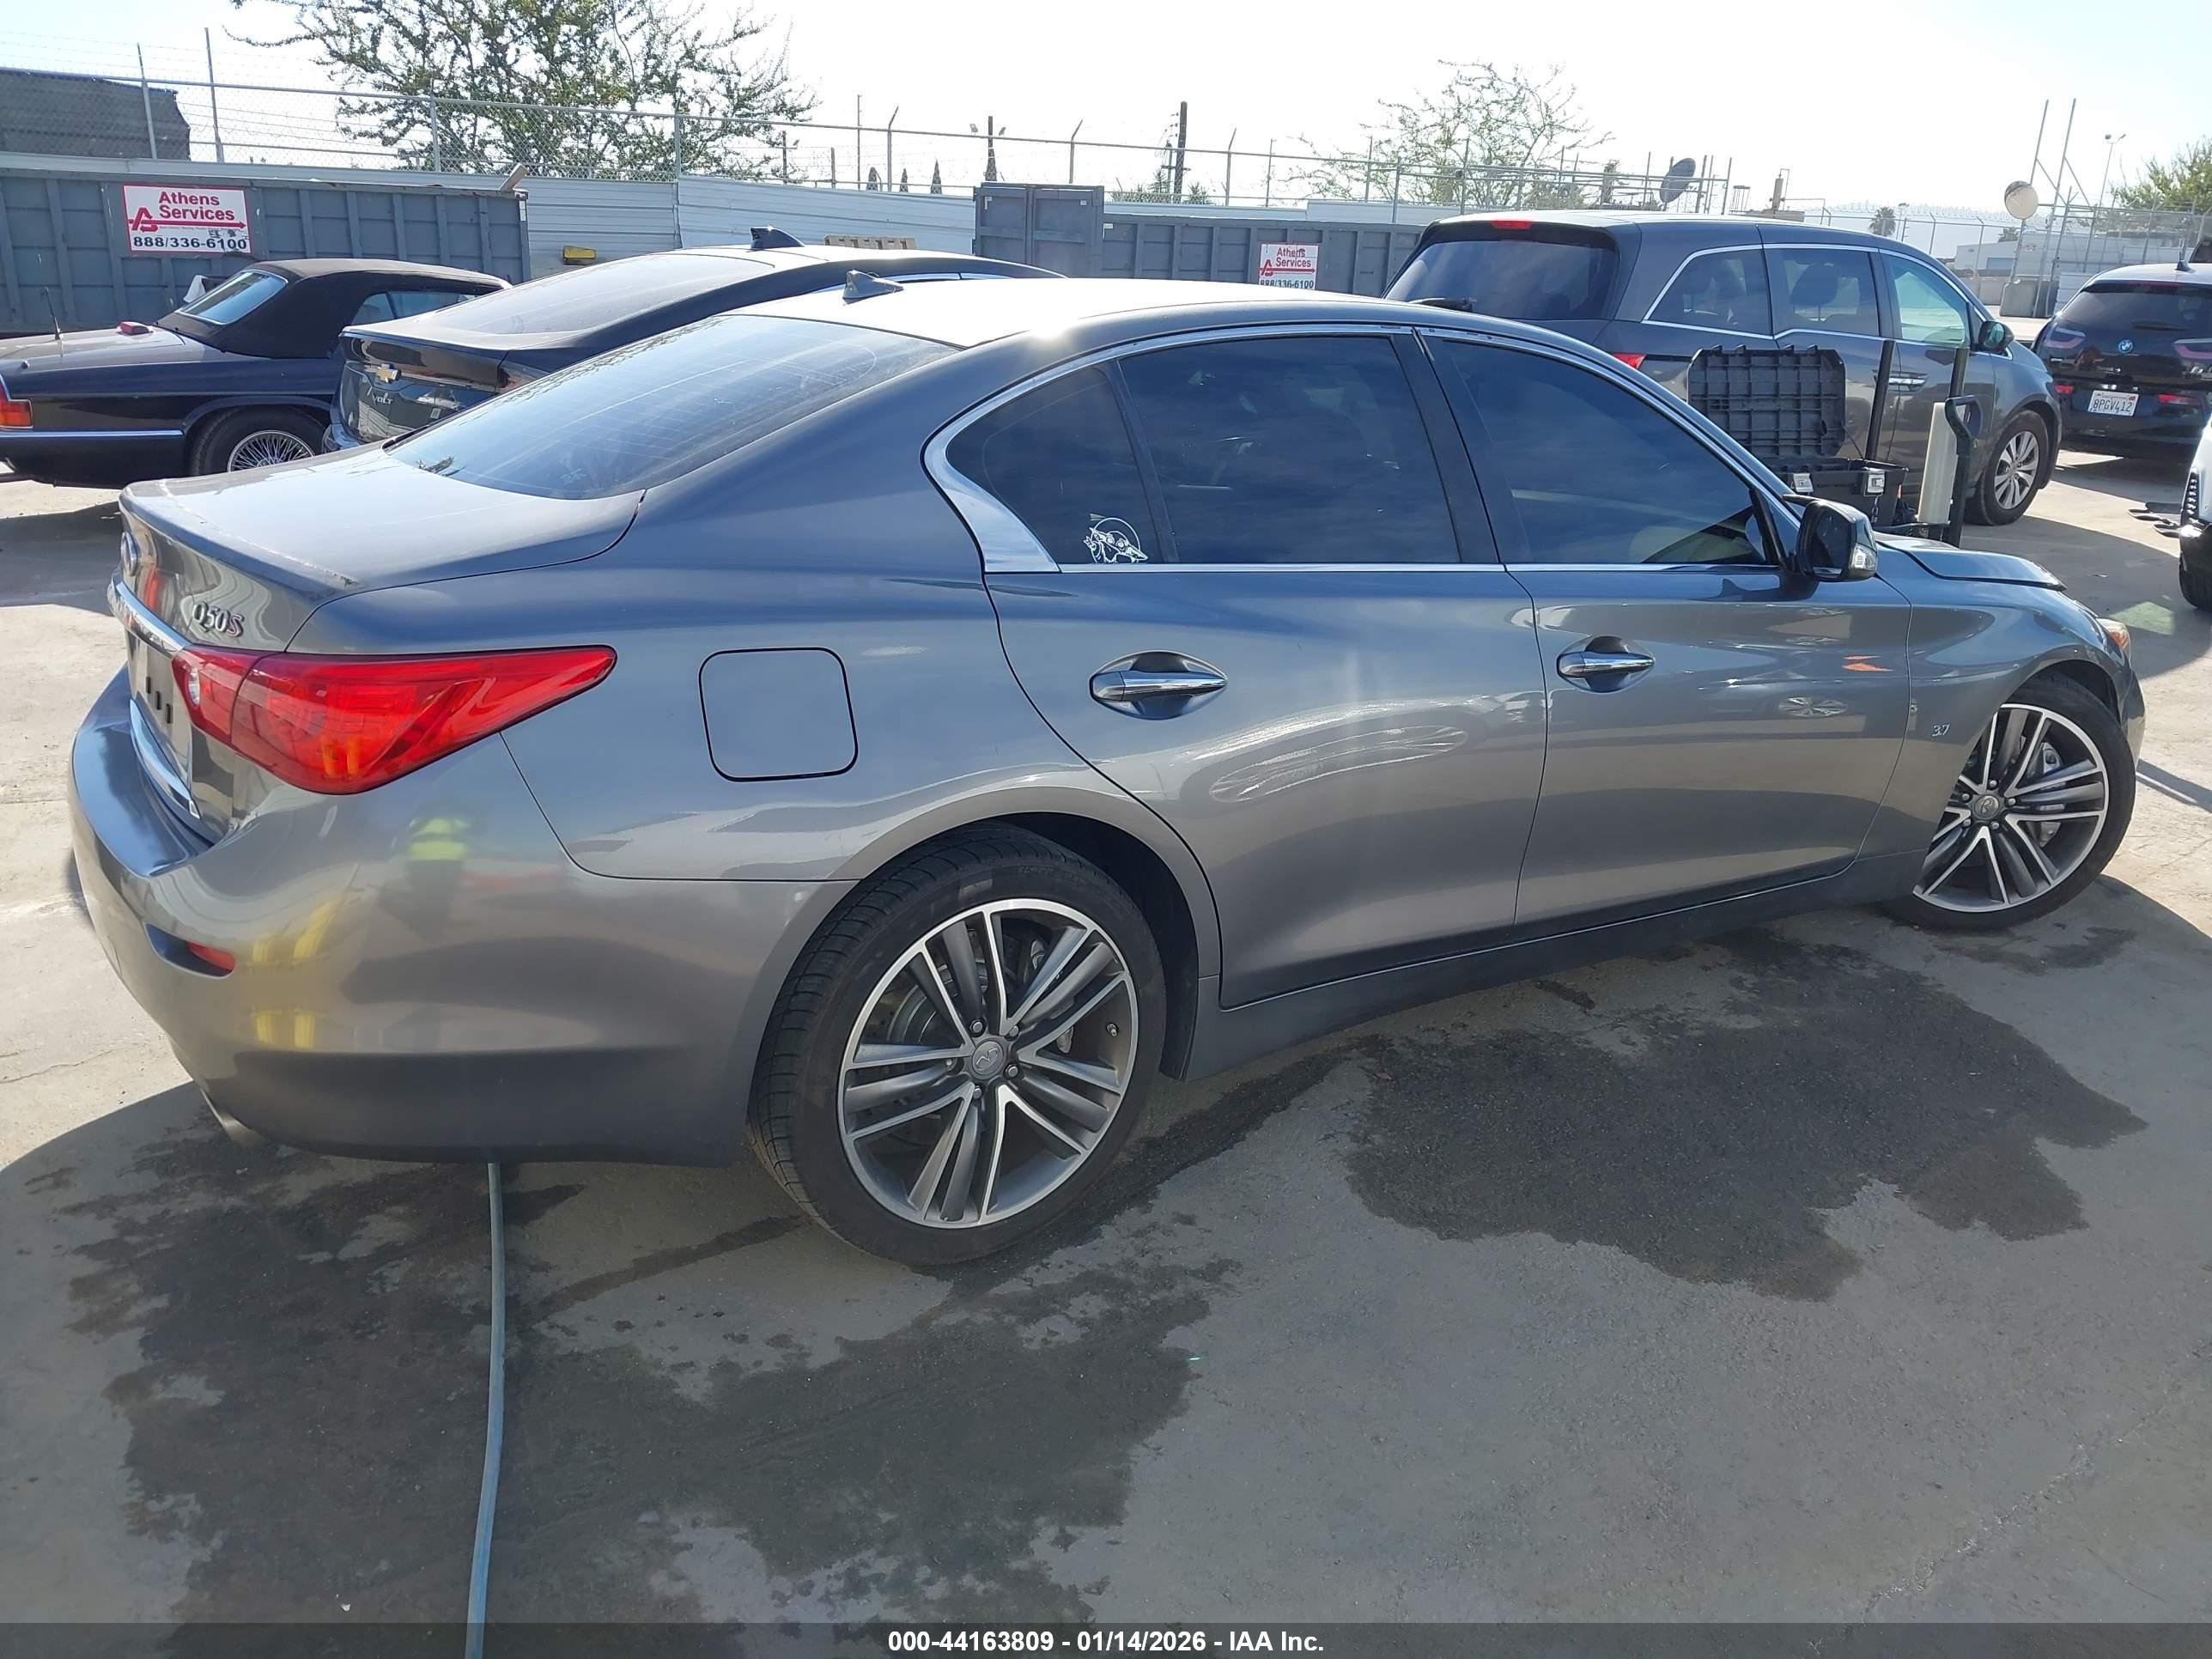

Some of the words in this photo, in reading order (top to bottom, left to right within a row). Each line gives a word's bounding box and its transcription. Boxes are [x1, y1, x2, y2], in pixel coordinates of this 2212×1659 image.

[158, 191, 220, 206] Athens
[159, 204, 235, 221] Services
[133, 236, 246, 250] 888/336-6100
[1276, 246, 1305, 258] Athens
[1275, 257, 1311, 268] Services
[2093, 398, 2133, 413] 8PGV412
[191, 602, 245, 637] Q50S
